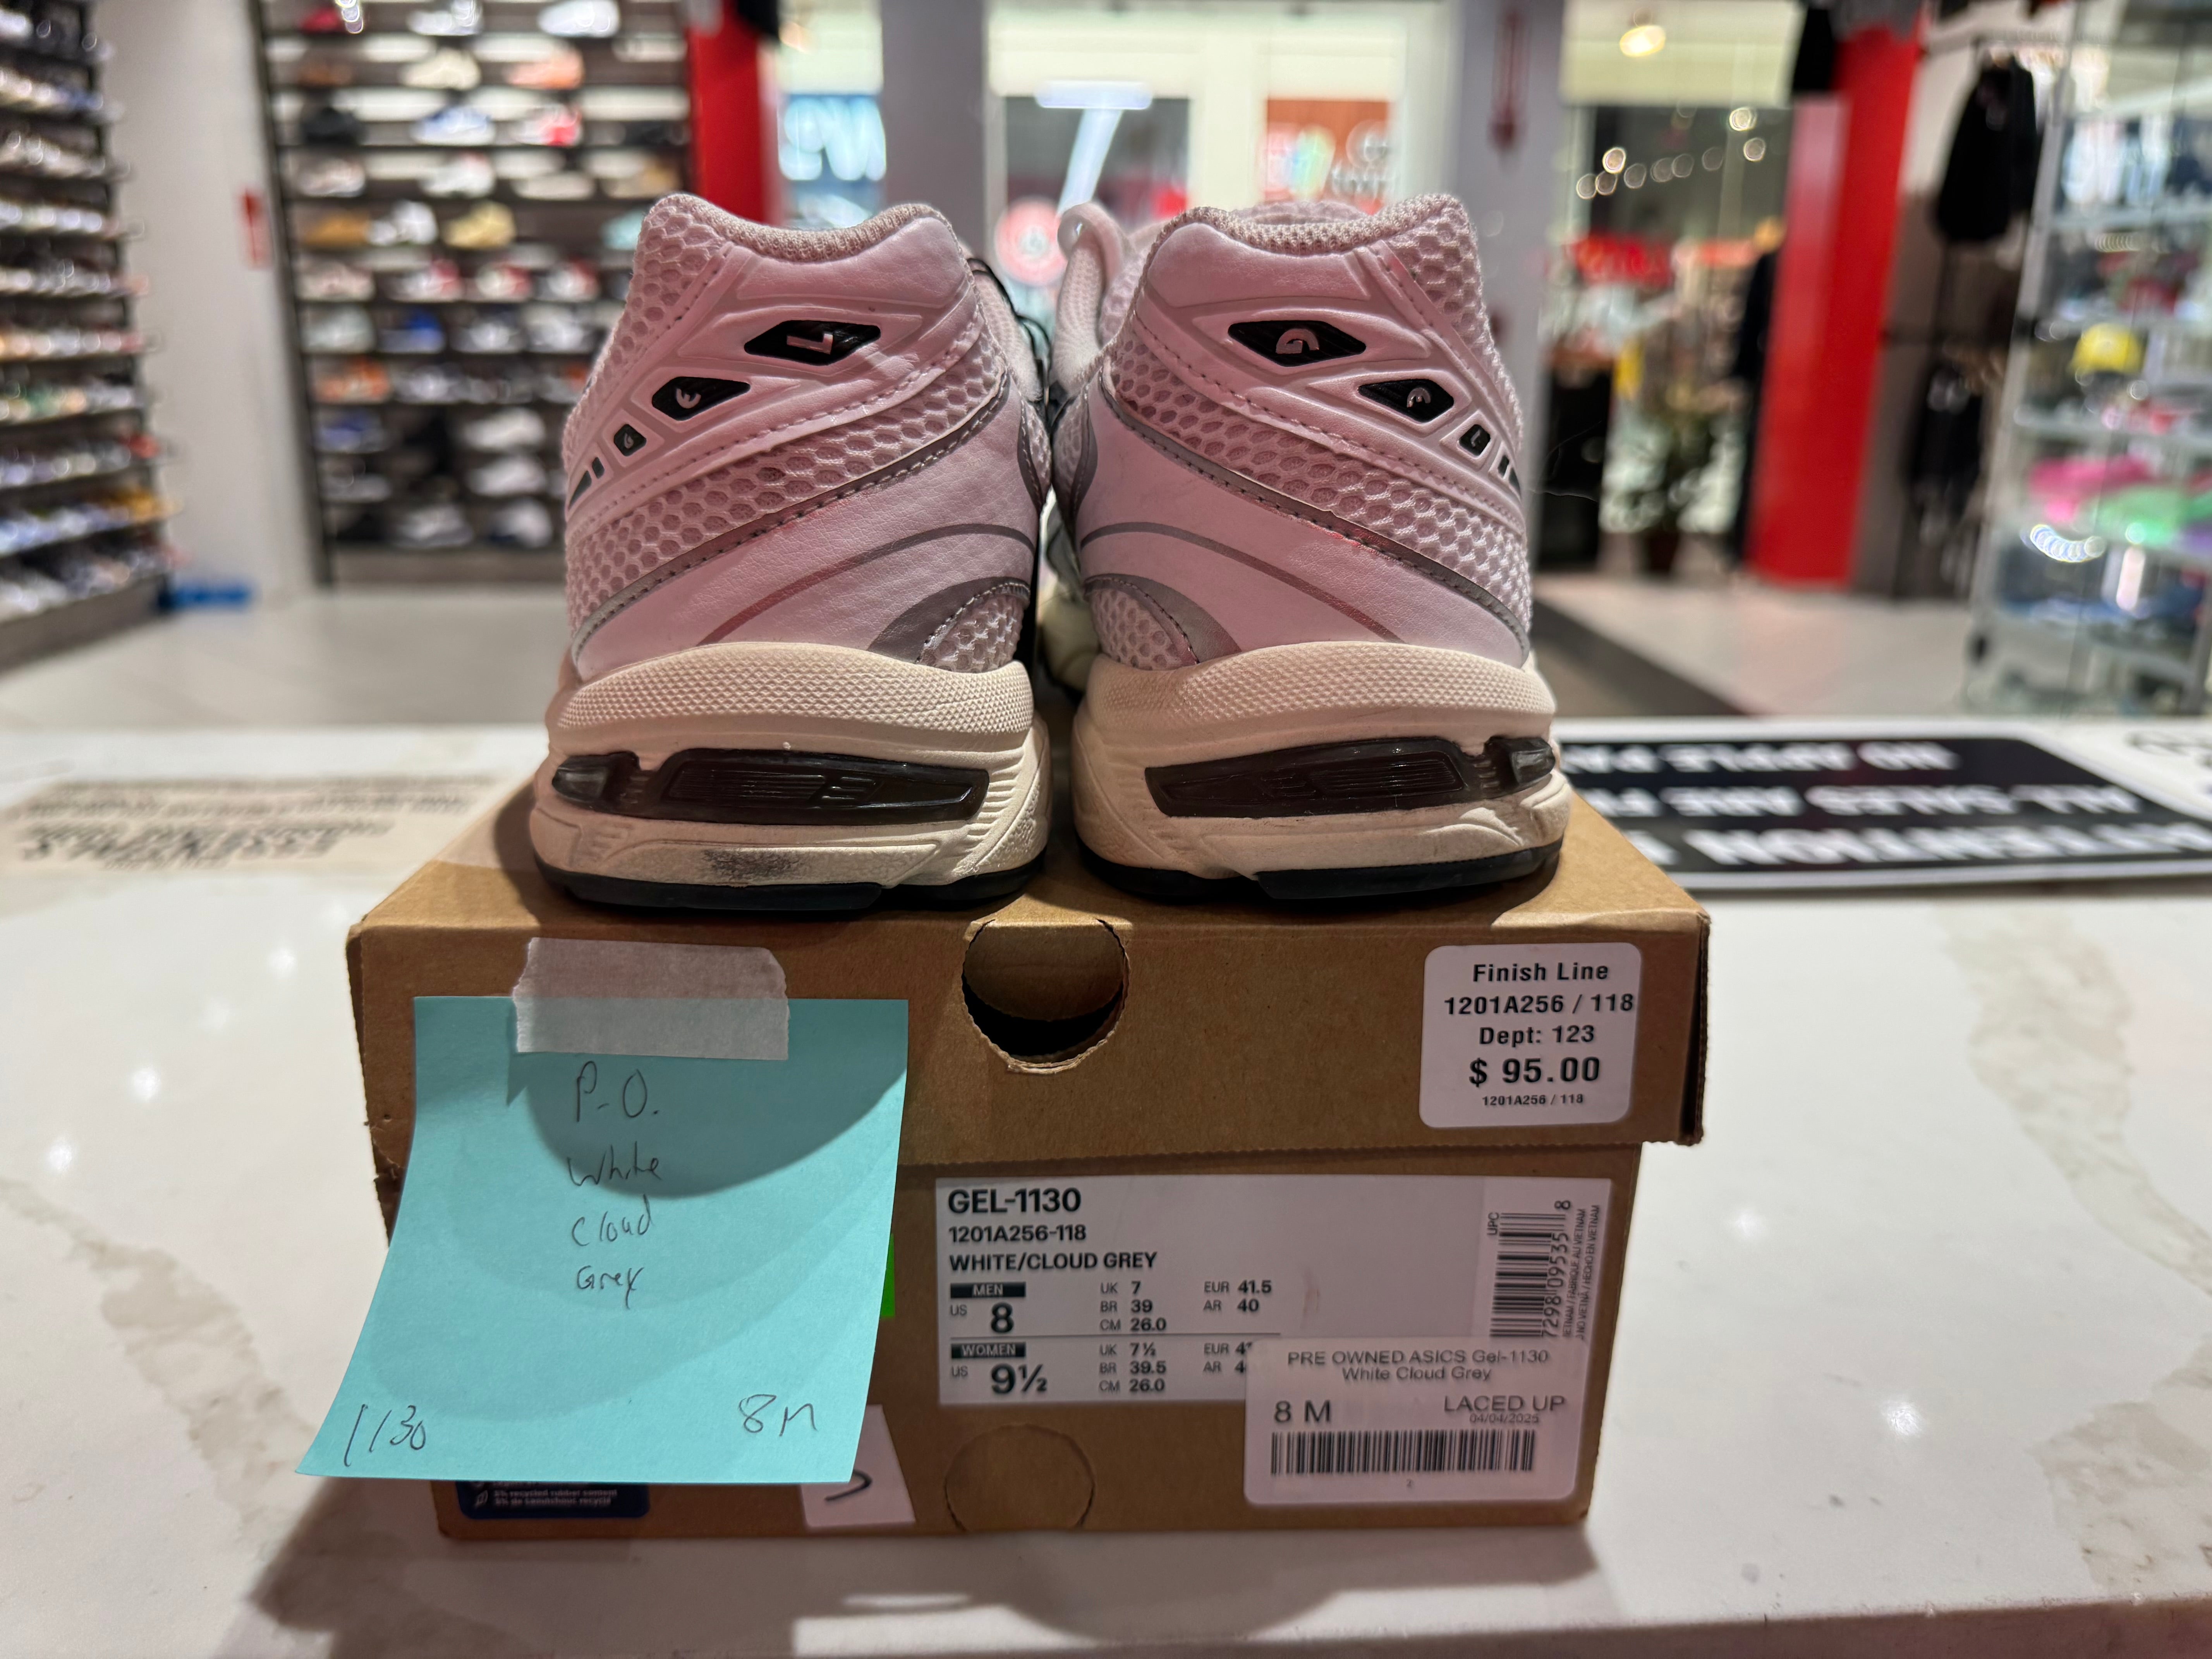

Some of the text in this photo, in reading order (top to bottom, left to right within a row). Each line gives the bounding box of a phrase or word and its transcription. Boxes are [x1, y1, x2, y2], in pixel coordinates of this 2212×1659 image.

[1473, 962, 1608, 982] Finish Line
[1444, 994, 1564, 1015] 1201A256
[1590, 993, 1633, 1012] 118
[1479, 1025, 1595, 1048] Dept: 123
[1502, 1056, 1600, 1084] 95.00
[1482, 1095, 1546, 1106] 1201A256
[1560, 1094, 1583, 1104] 118
[948, 1188, 1081, 1213] GEL-1130
[1554, 1199, 1571, 1211] 8
[1487, 1212, 1500, 1236] UPC
[1587, 1204, 1600, 1242] VIETNAM
[949, 1224, 1086, 1242] 1201A256-118
[950, 1252, 1157, 1271] WHITE/CLOUD GREY
[1546, 1233, 1569, 1288] 09535
[1563, 1305, 1575, 1337] IETNAM
[1574, 1208, 1586, 1245] VIETNAM
[972, 1284, 1003, 1297] MEN
[1101, 1280, 1272, 1294] UK 7 EUR 41.5
[1101, 1299, 1259, 1313] BR 39 AR 40
[951, 1302, 1014, 1333] US 8
[1100, 1318, 1166, 1331] CM 26.0
[962, 1344, 1016, 1357] WOMEN
[1100, 1344, 1117, 1355] UK
[1204, 1343, 1229, 1354] EUR
[1288, 1349, 1548, 1365] PRE OWNED ASICS Gel-1130
[952, 1366, 968, 1377] US
[1100, 1363, 1117, 1374] BR
[1130, 1361, 1166, 1374] 39.5
[1203, 1362, 1221, 1373] AR
[1342, 1366, 1492, 1381] White Cloud Grey
[1099, 1379, 1165, 1392] CM 26.0
[1274, 1395, 1565, 1423] 8 M LACED UP
